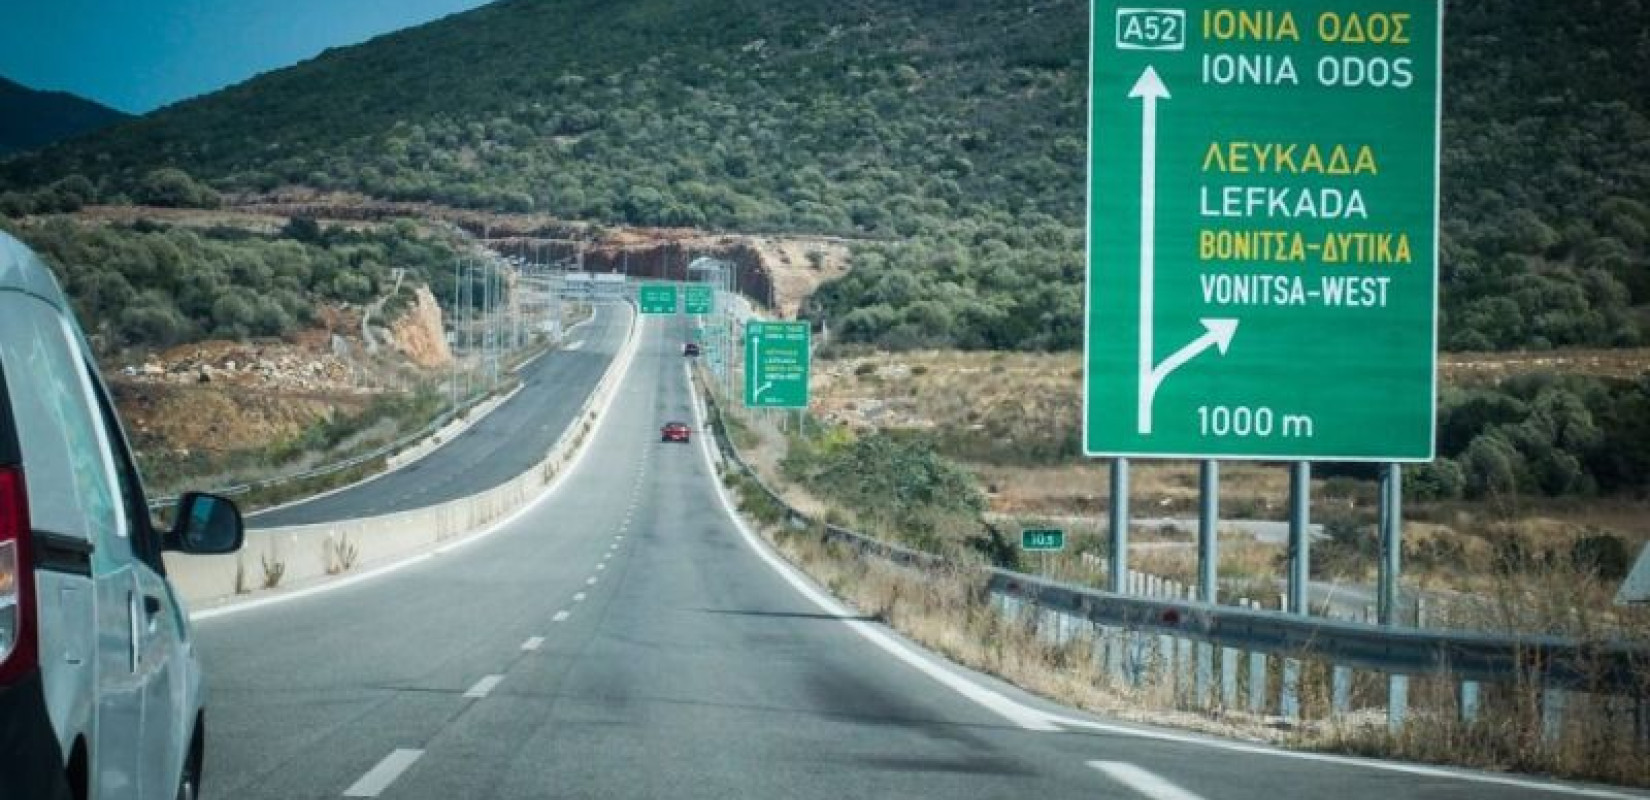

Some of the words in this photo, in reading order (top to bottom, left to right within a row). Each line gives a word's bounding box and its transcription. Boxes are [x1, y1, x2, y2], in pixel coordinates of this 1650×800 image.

[1123, 16, 1178, 42] A52
[1202, 10, 1300, 41] ΙΟΝΙΑ
[1318, 12, 1411, 43] ΟΔΟΣ
[1202, 54, 1299, 85] IONIA
[1317, 56, 1414, 88] ODOS
[1202, 142, 1378, 175] ΛΕΥΚΑΔΑ
[1200, 186, 1368, 218] LEFKADA
[1199, 230, 1412, 263] ΒΟΝΙΤΣΑ-ΔΥΤΙΚΑ
[1200, 273, 1391, 307] VONITSA-WEST
[1197, 405, 1274, 436] 1000
[1282, 414, 1313, 436] m
